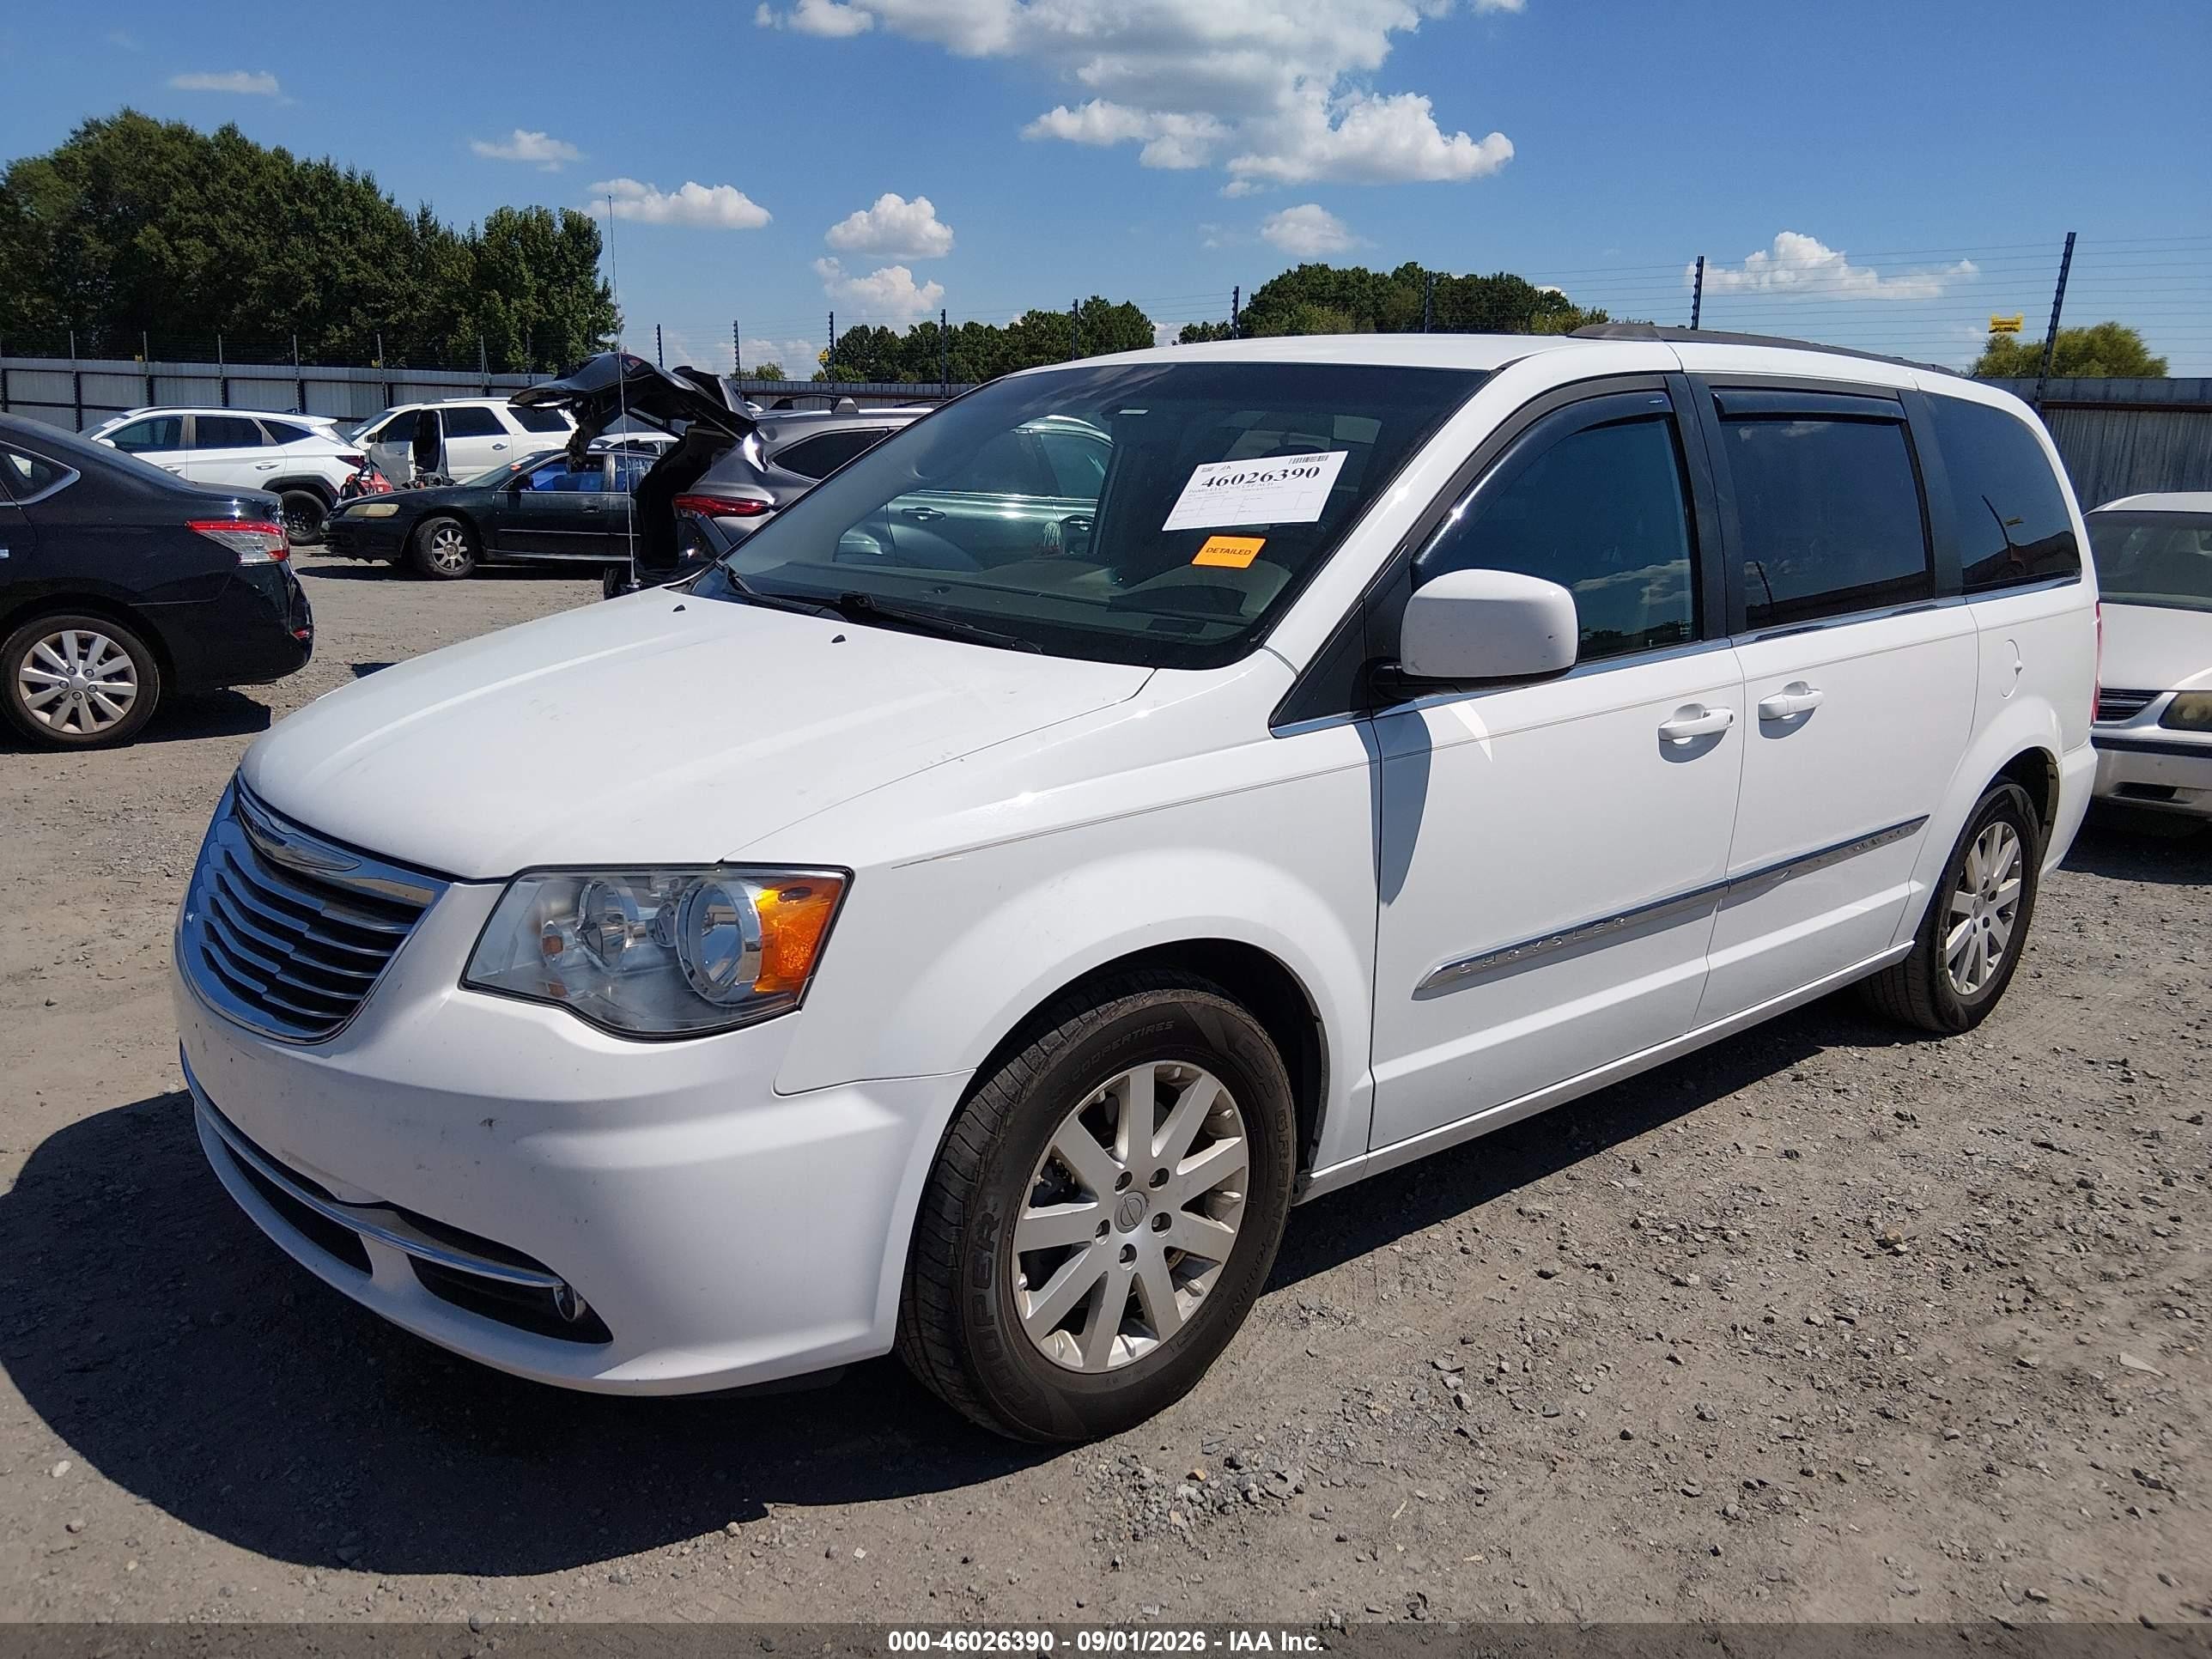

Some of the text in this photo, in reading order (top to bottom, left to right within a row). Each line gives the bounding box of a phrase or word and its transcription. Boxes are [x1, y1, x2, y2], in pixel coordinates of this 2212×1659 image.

[1200, 466, 1321, 488] 46026390
[1205, 547, 1252, 556] DETAILED
[1459, 917, 1626, 974] CHRYSLER
[972, 1212, 1030, 1408] COOPER
